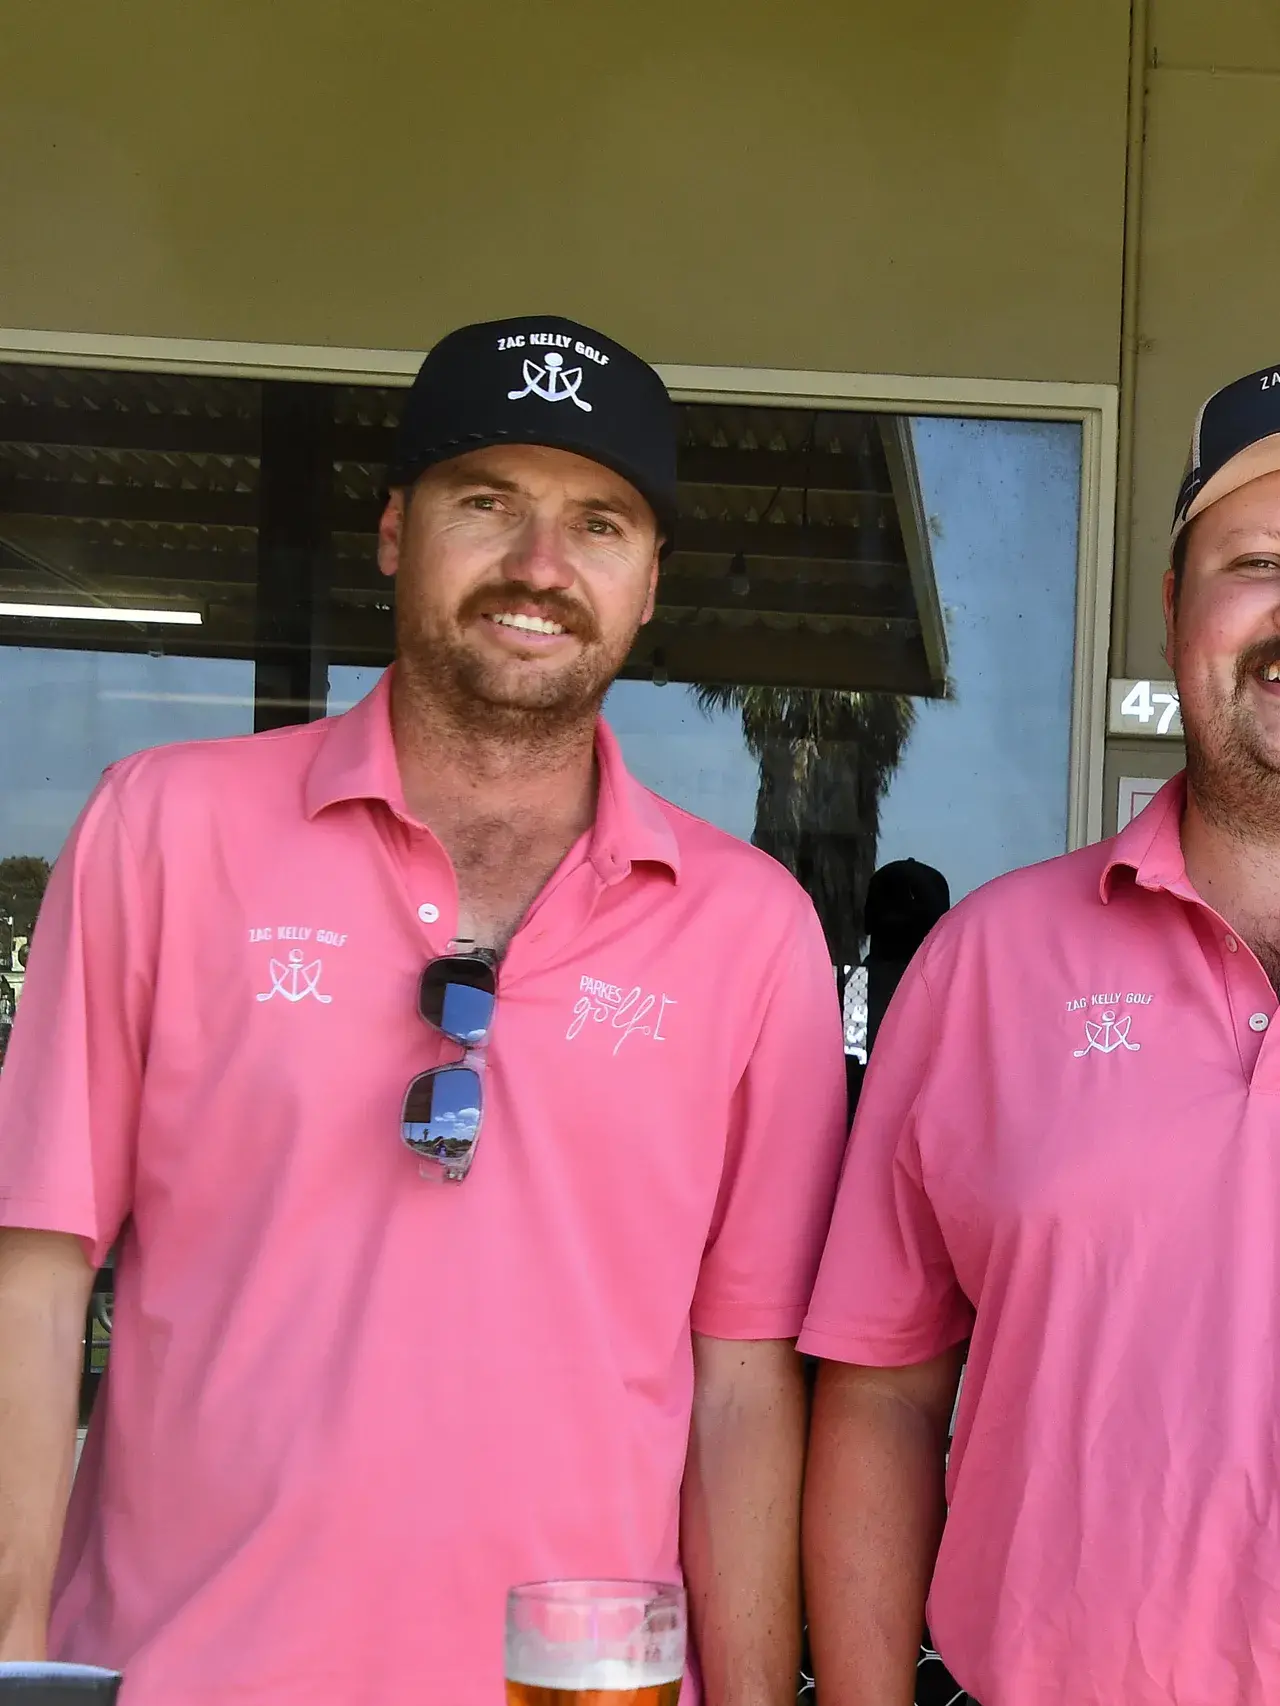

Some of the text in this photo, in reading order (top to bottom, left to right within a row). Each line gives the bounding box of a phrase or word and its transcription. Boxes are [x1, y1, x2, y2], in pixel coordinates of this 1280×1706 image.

[497, 333, 610, 366] ZAC KELLY GOLF
[248, 926, 348, 947] ZAC KELLY GOLF
[580, 975, 623, 1003] PARKES
[1066, 993, 1154, 1012] ZAC KELLY GOLF
[565, 986, 651, 1056] golf
